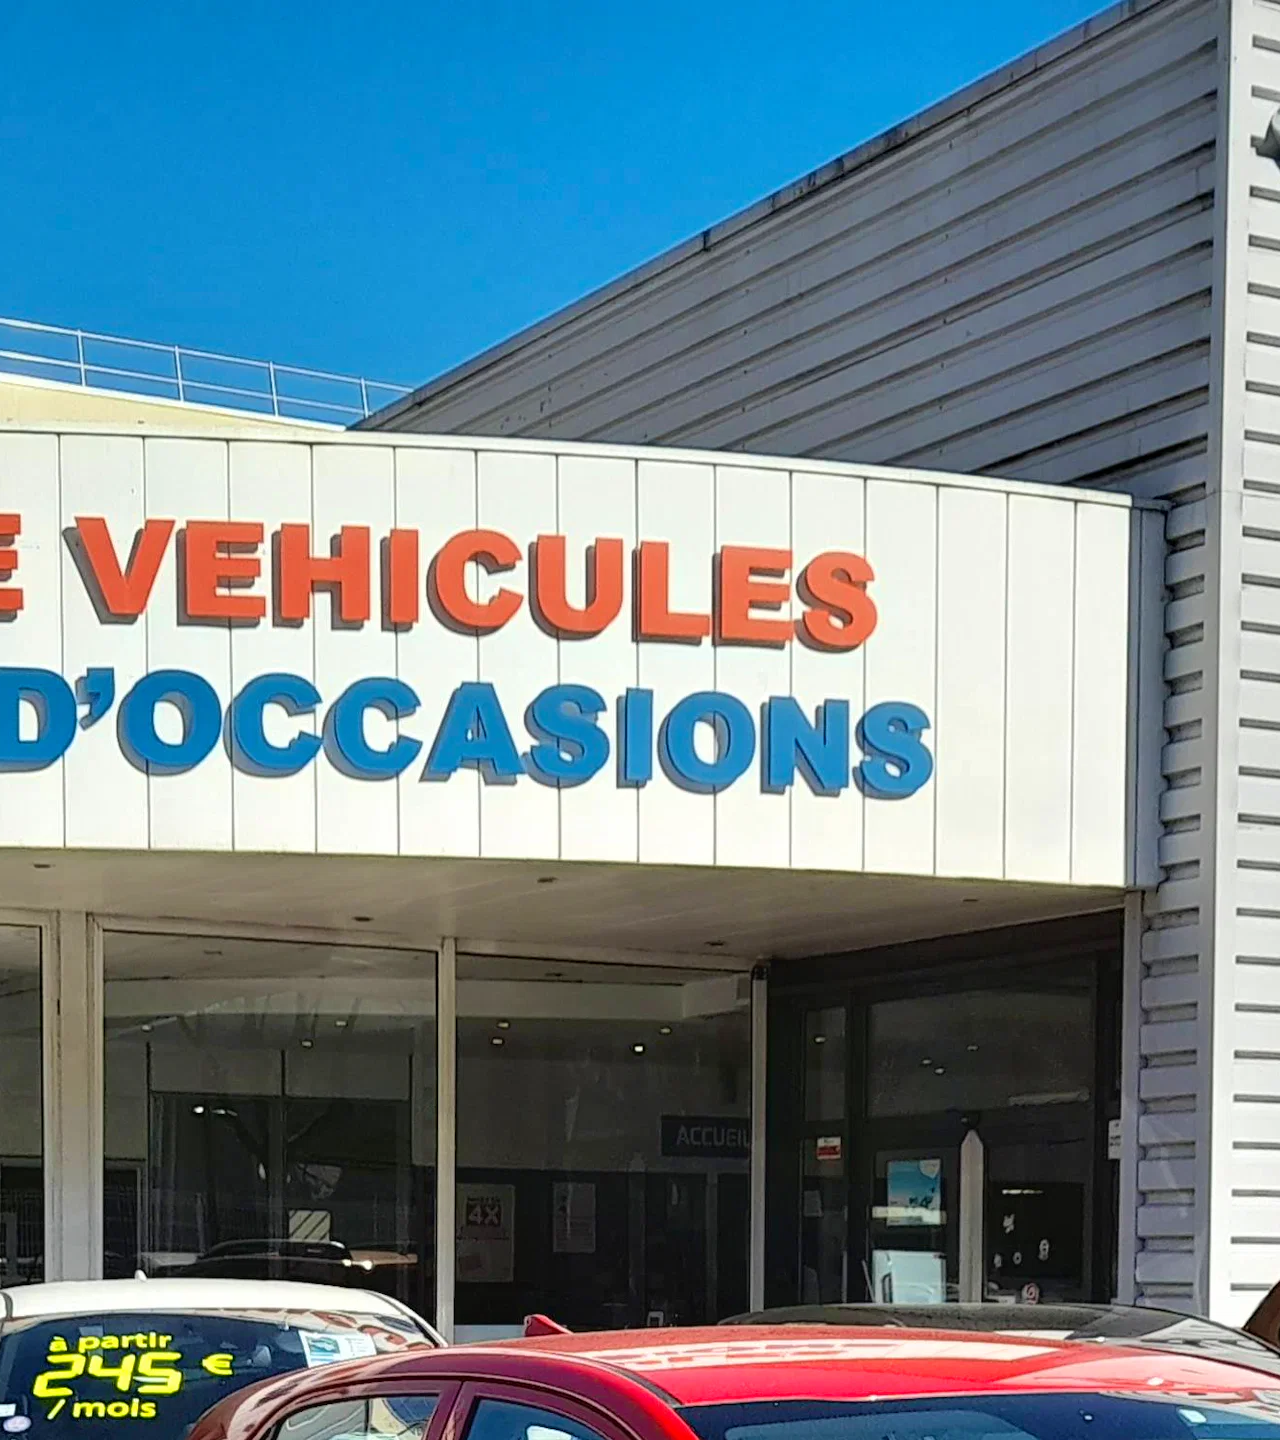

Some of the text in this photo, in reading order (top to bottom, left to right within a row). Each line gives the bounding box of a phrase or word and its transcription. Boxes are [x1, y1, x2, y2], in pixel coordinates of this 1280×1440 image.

[74, 517, 878, 648] VEHICULES
[49, 1332, 172, 1353] à partir
[33, 1351, 234, 1398] 245 €
[72, 1398, 157, 1419] mois
